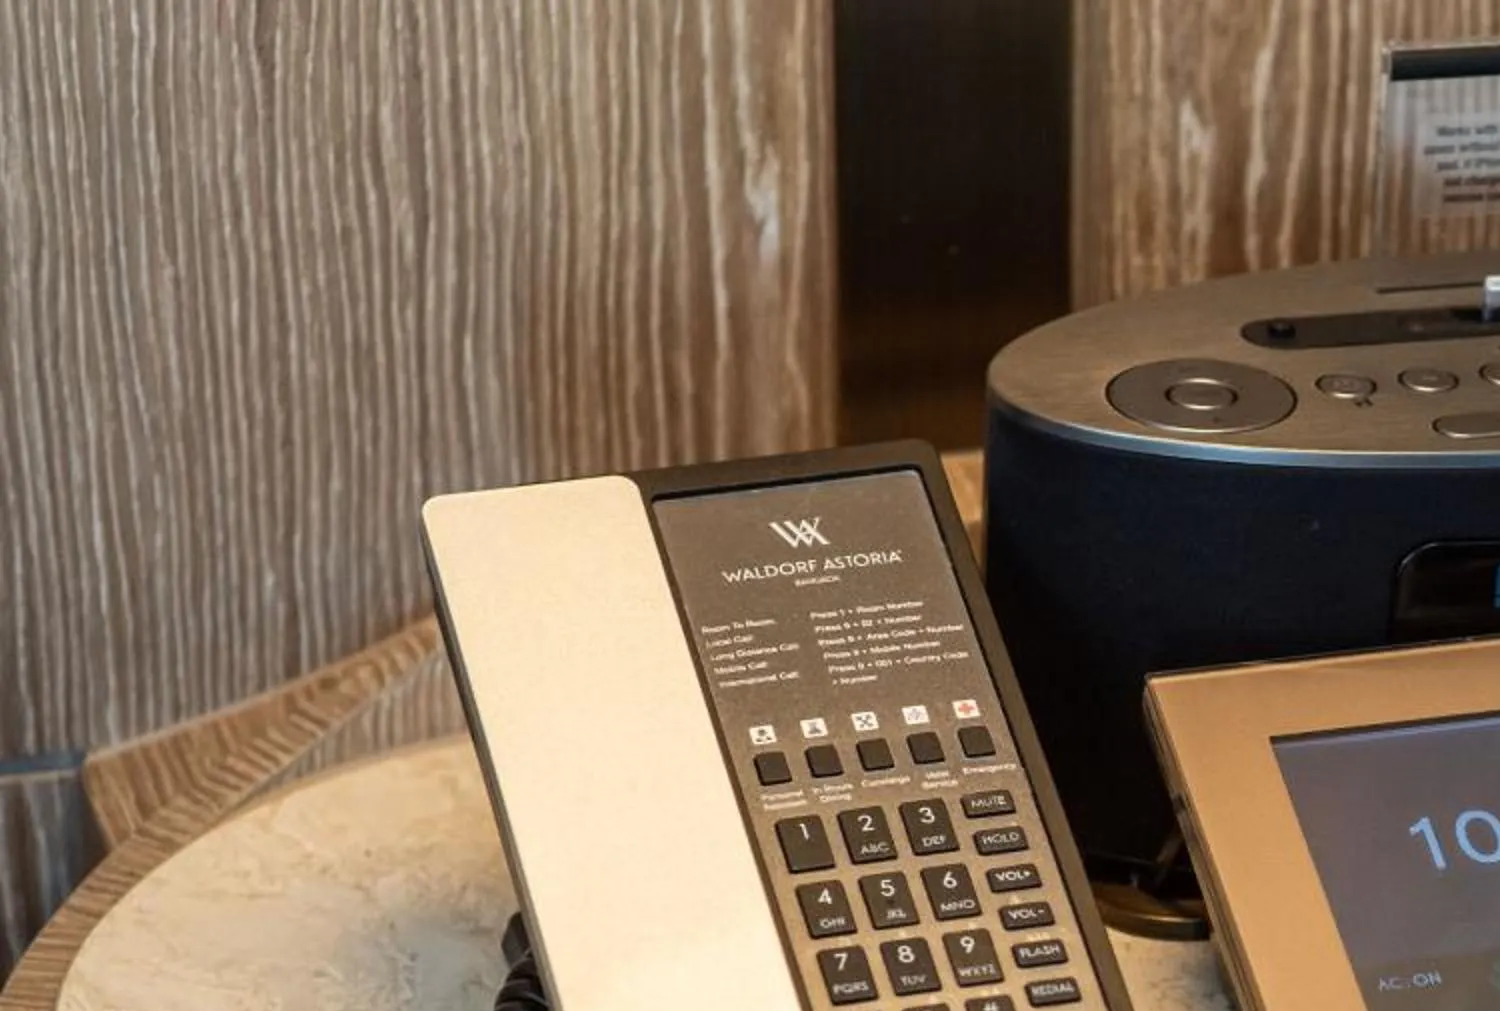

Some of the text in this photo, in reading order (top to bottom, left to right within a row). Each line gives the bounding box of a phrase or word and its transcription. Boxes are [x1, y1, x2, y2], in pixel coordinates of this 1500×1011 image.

[720, 550, 902, 584] WALDORF ASTORIA
[971, 795, 1008, 808] MUTE
[857, 814, 876, 832] 2
[918, 806, 936, 824] 3
[799, 823, 810, 841] 1
[921, 834, 947, 847] DEF
[981, 831, 1020, 845] HOLD
[860, 841, 890, 855] ABC
[880, 879, 896, 897] 5
[943, 871, 958, 889] 6
[818, 888, 833, 905] 4
[939, 899, 976, 912] MNO
[959, 936, 975, 954] 9
[1018, 944, 1062, 958] FLASH
[834, 952, 849, 971] 7
[897, 945, 915, 963] 8
[958, 963, 997, 978] WXYZ
[899, 974, 927, 986] TUV
[1029, 981, 1075, 996] REDIAL
